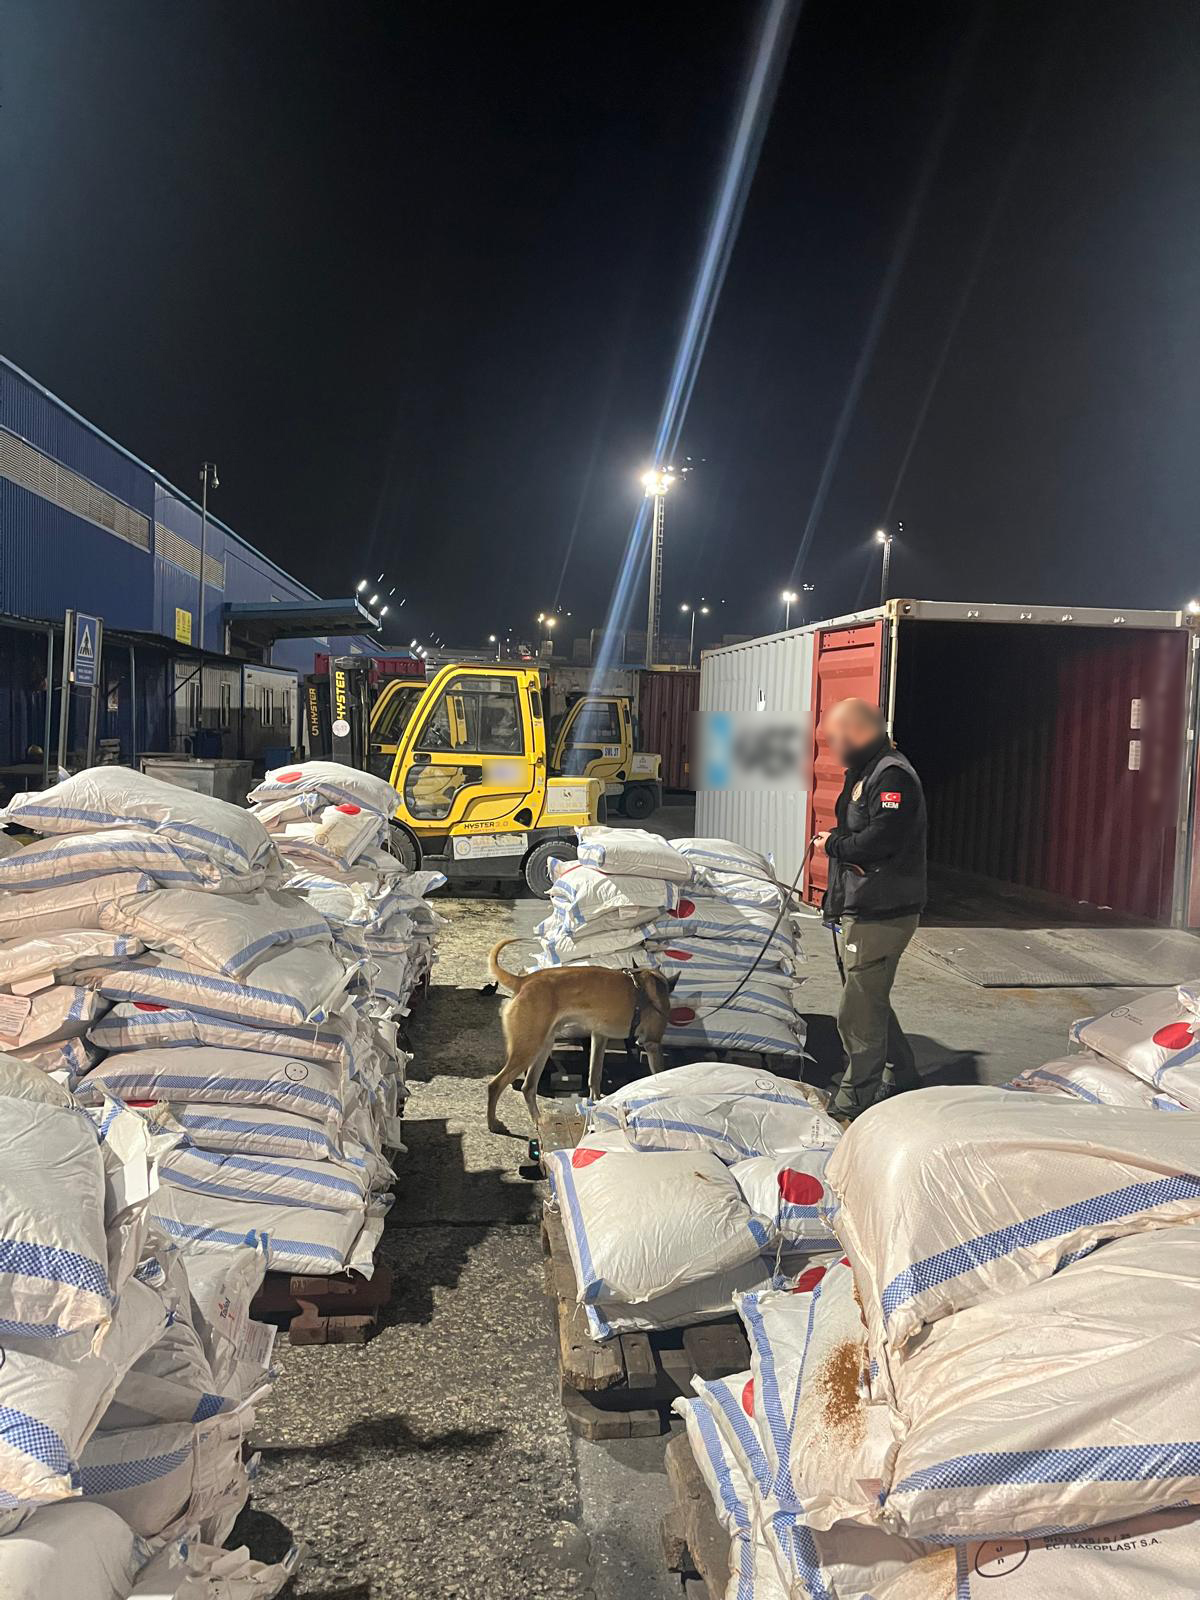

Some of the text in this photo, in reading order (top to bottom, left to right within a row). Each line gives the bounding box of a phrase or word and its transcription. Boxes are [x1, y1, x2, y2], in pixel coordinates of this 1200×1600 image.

[335, 671, 346, 720] HYSTER
[309, 688, 318, 725] HYSTER
[882, 801, 899, 809] KEM
[464, 821, 494, 829] HYSTER
[1070, 1541, 1136, 1552] SACOPLAST
[1140, 1537, 1162, 1547] S.A.
